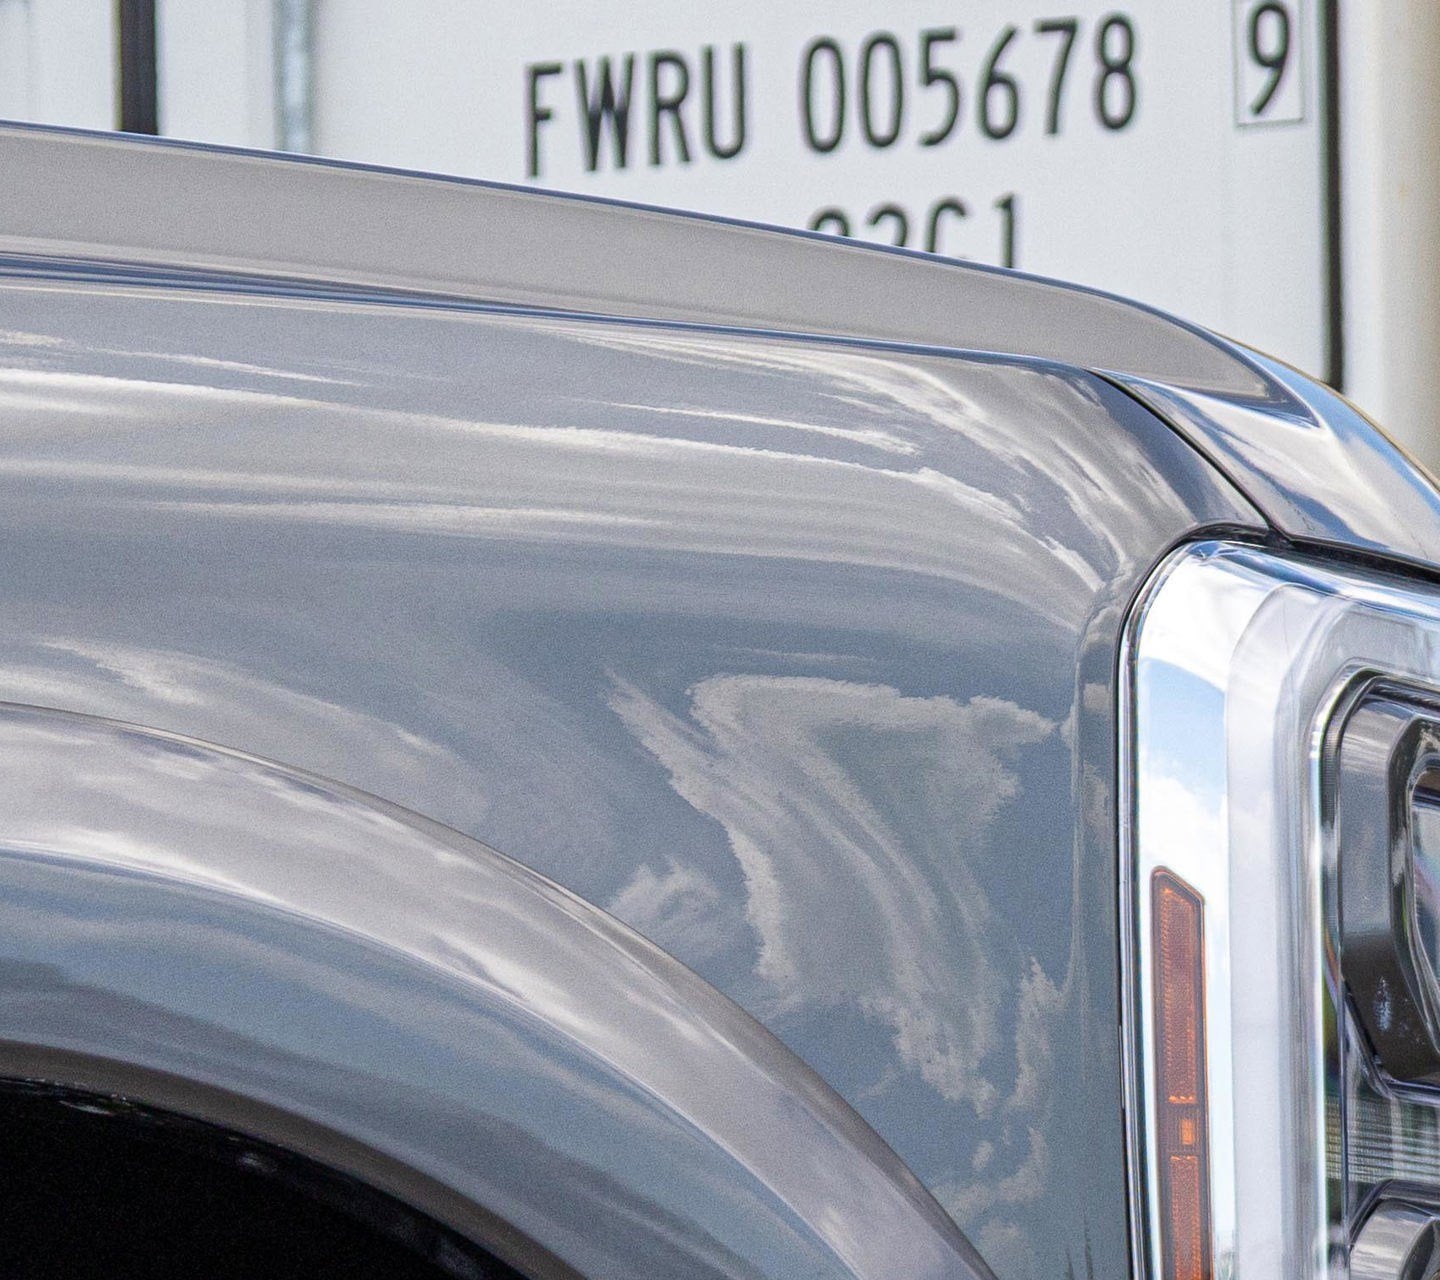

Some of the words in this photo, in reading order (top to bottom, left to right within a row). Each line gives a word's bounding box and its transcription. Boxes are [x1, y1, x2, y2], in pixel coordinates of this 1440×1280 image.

[524, 42, 748, 179] FWRU
[803, 14, 1138, 153] 005678
[1248, 1, 1291, 117] 9
